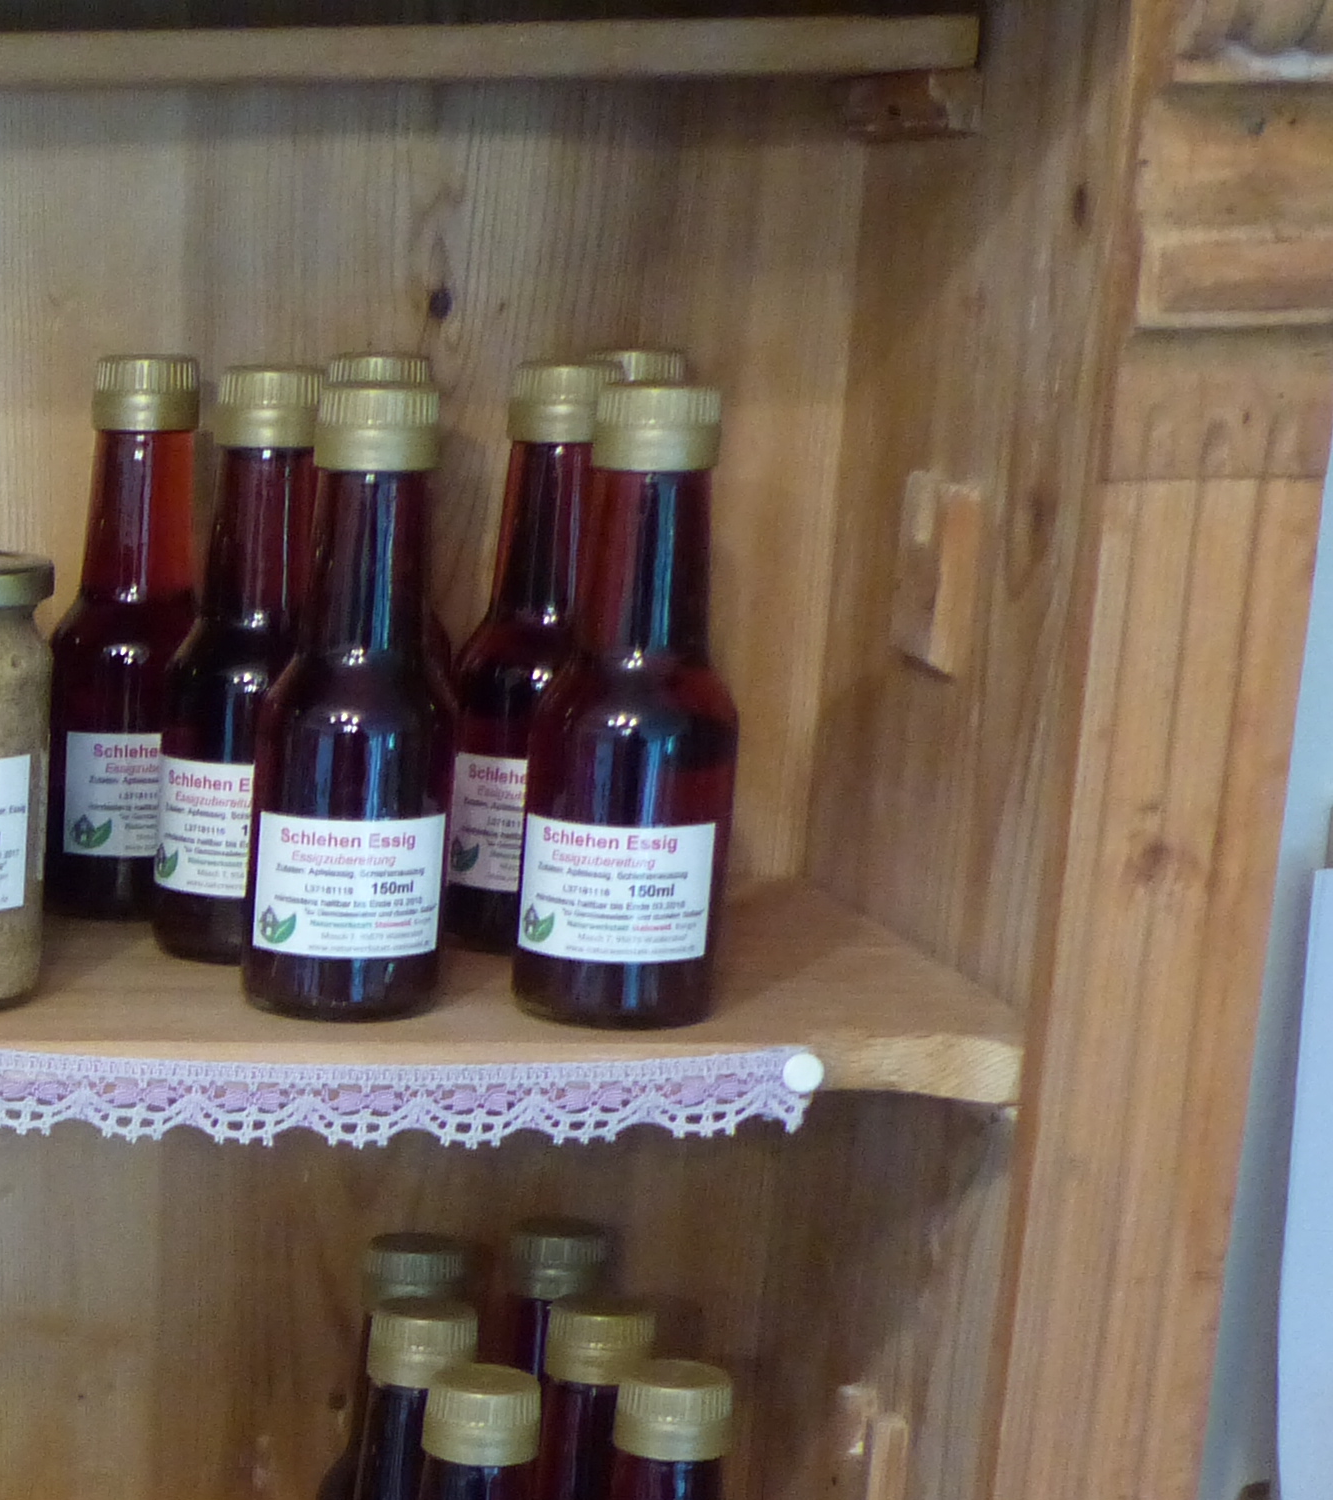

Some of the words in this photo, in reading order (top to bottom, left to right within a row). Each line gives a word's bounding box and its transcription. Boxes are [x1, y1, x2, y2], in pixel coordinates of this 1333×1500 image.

[93, 744, 158, 758] Schlehe
[169, 769, 232, 791] Schlehen
[469, 764, 526, 784] Schlehe
[281, 828, 361, 848] Schlehen
[369, 833, 416, 850] Essig
[544, 826, 619, 849] Schlehen
[627, 835, 678, 853] Essig
[292, 852, 396, 867] Essigzubereitung
[552, 850, 655, 870] Essigzubereitung
[371, 880, 414, 895] 150ml
[628, 885, 675, 897] 150ml
